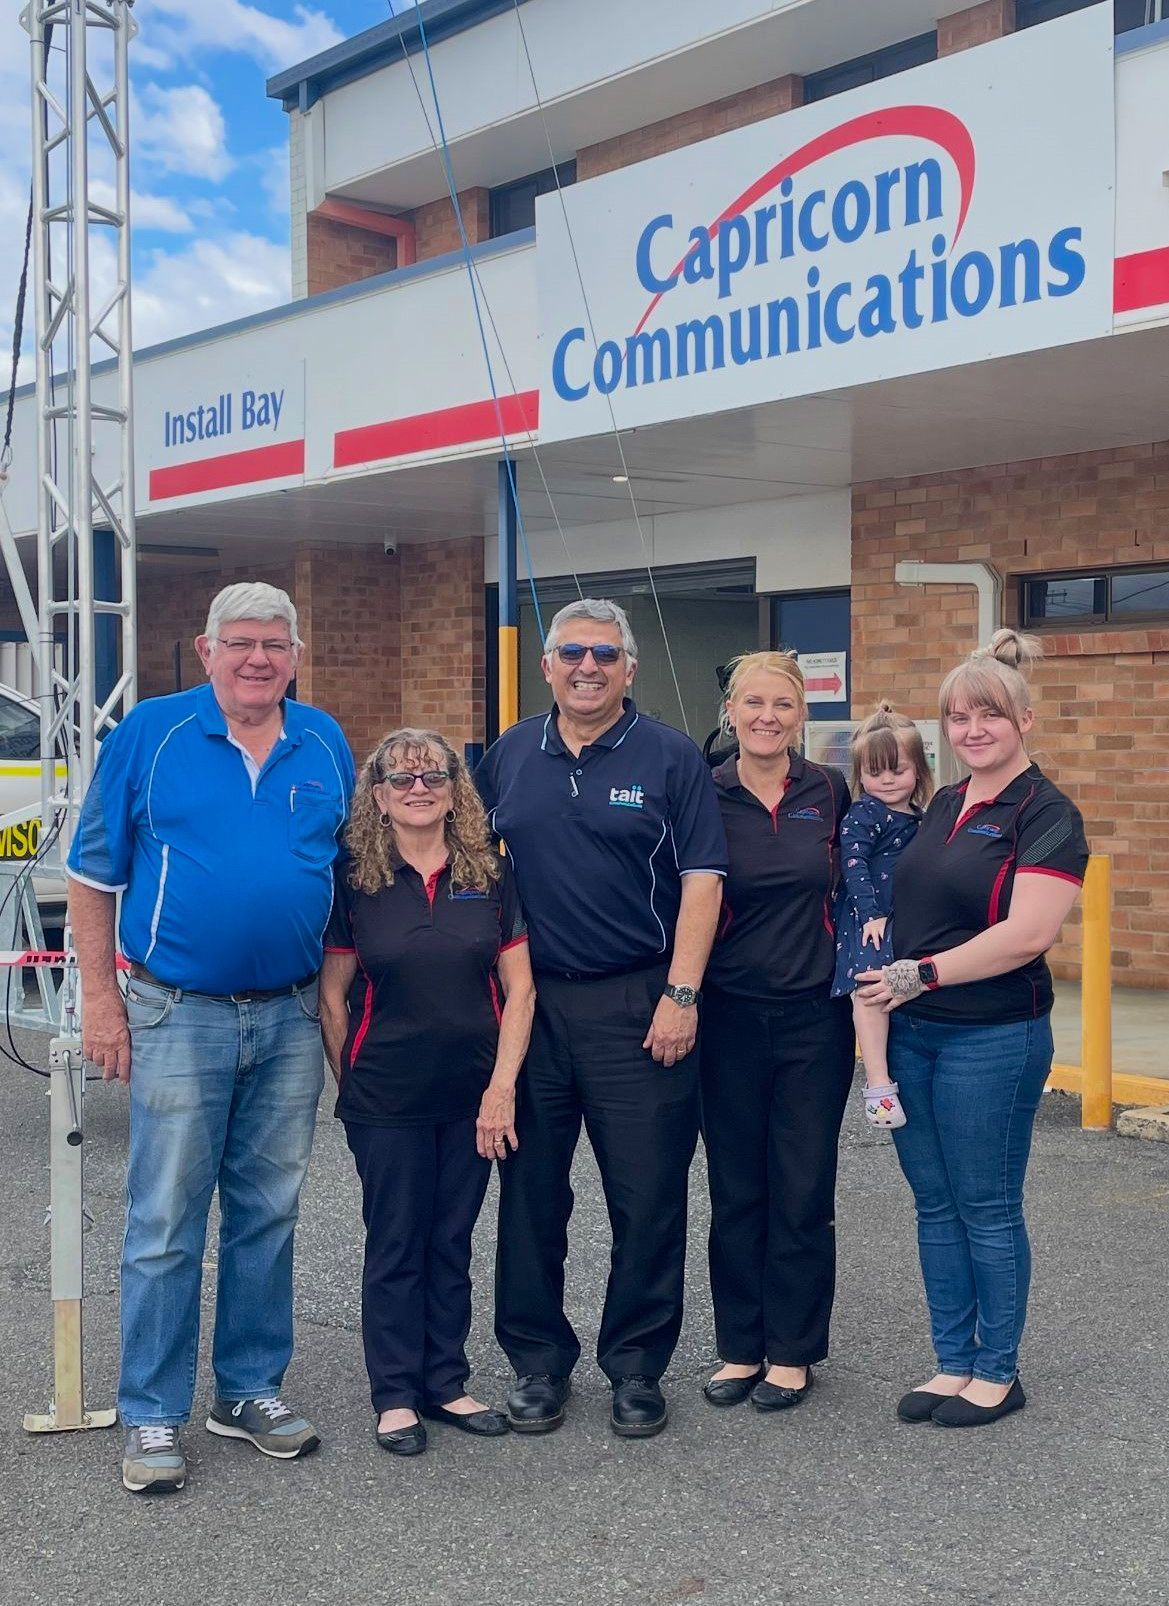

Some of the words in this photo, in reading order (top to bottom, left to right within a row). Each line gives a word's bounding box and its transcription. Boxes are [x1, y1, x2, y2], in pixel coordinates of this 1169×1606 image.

[636, 157, 943, 299] Capricorn
[552, 226, 1087, 402] Communications
[165, 393, 232, 447] Install
[242, 389, 285, 431] Bay
[609, 785, 644, 804] tait
